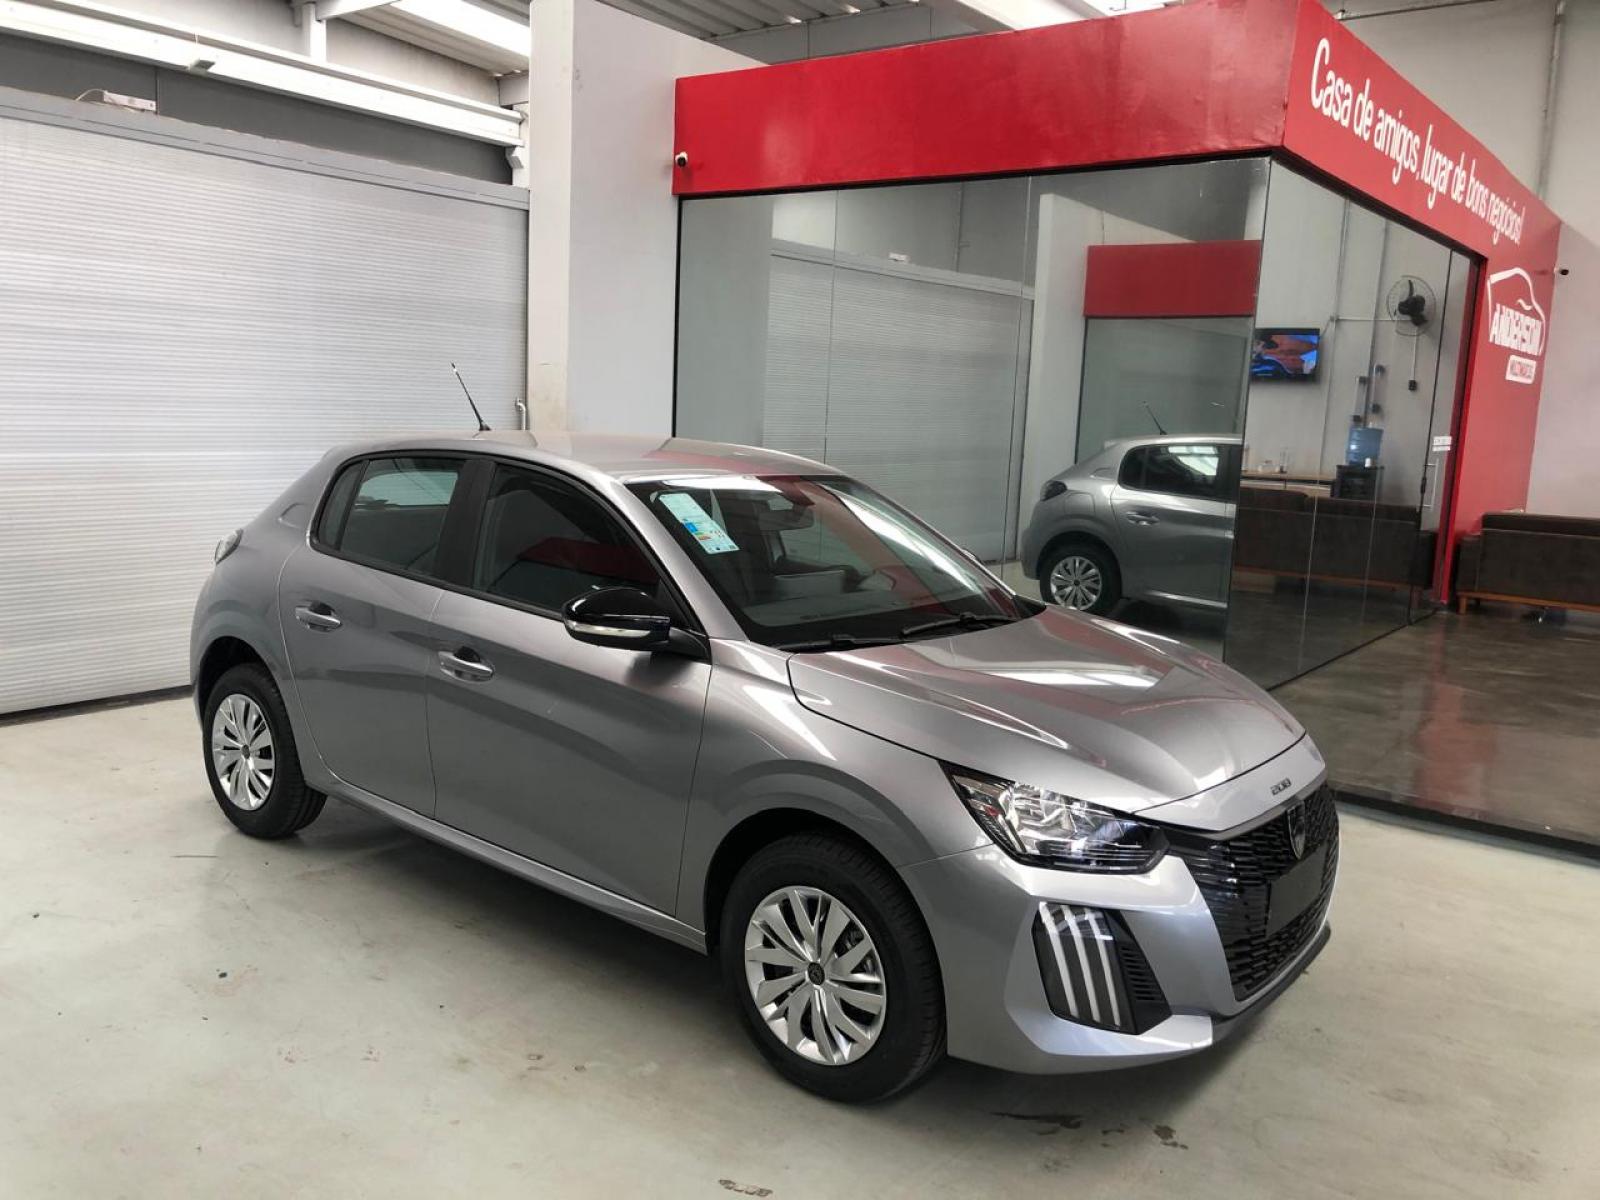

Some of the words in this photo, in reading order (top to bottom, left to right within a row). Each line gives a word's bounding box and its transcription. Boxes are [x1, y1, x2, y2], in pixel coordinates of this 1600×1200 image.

[1310, 37, 1354, 129] Casa
[1353, 77, 1374, 142] de
[1373, 107, 1421, 185] amigos,
[1420, 123, 1454, 210] lugar
[1450, 151, 1467, 204] de
[1464, 158, 1490, 219] bons
[1486, 191, 1526, 246] negócios!
[1489, 302, 1542, 356] ANDERSON
